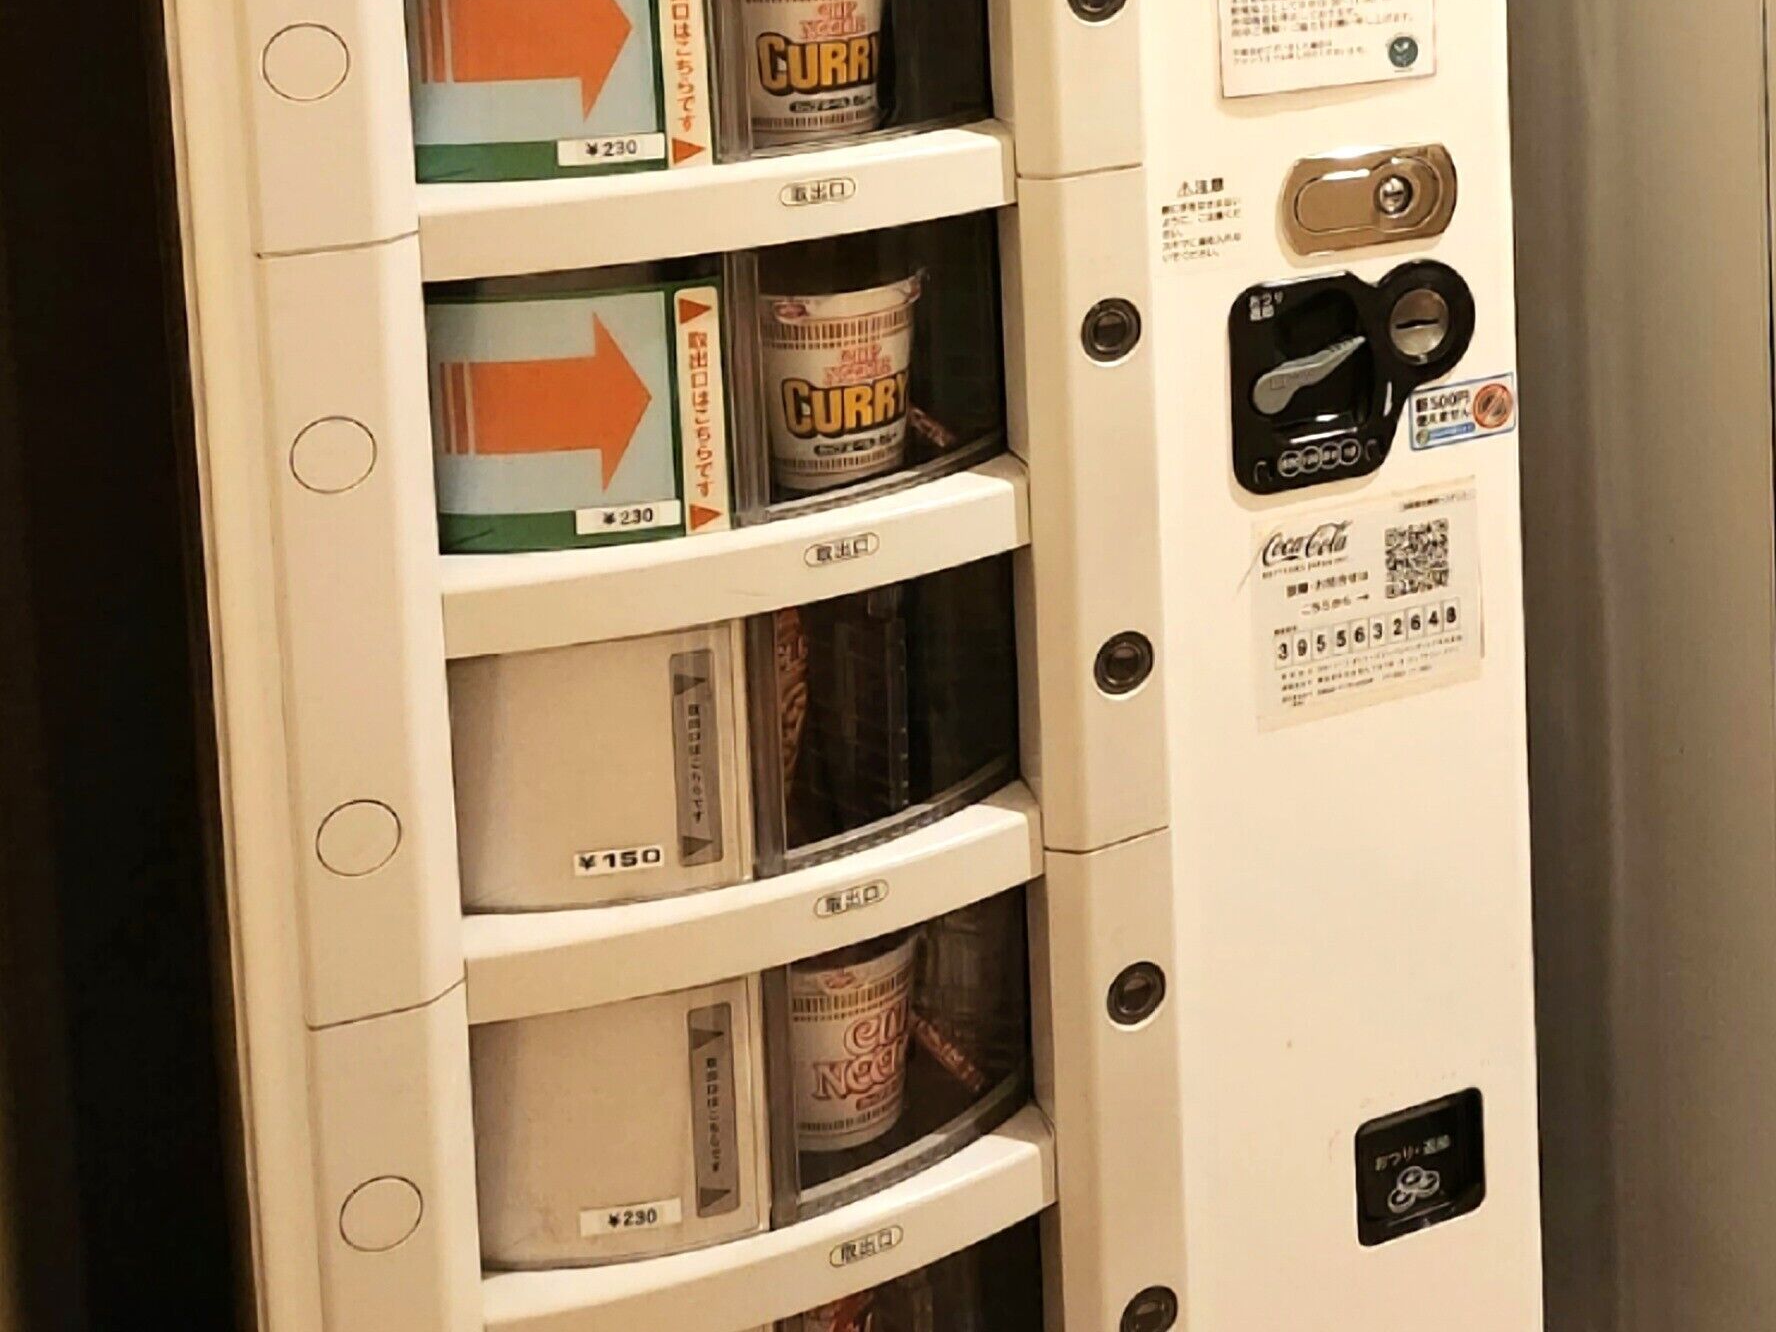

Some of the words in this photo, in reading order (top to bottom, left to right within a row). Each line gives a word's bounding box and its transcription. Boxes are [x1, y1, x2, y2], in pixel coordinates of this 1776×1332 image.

[756, 33, 878, 96] CURR
[585, 138, 637, 158] ¥230
[791, 181, 845, 203] 取出口
[602, 506, 654, 527] ¥230
[816, 536, 870, 562] 取出口
[578, 846, 662, 871] ¥150
[825, 884, 881, 911] 取出口
[607, 1206, 658, 1228] ¥230
[840, 1228, 894, 1263] 取出口
